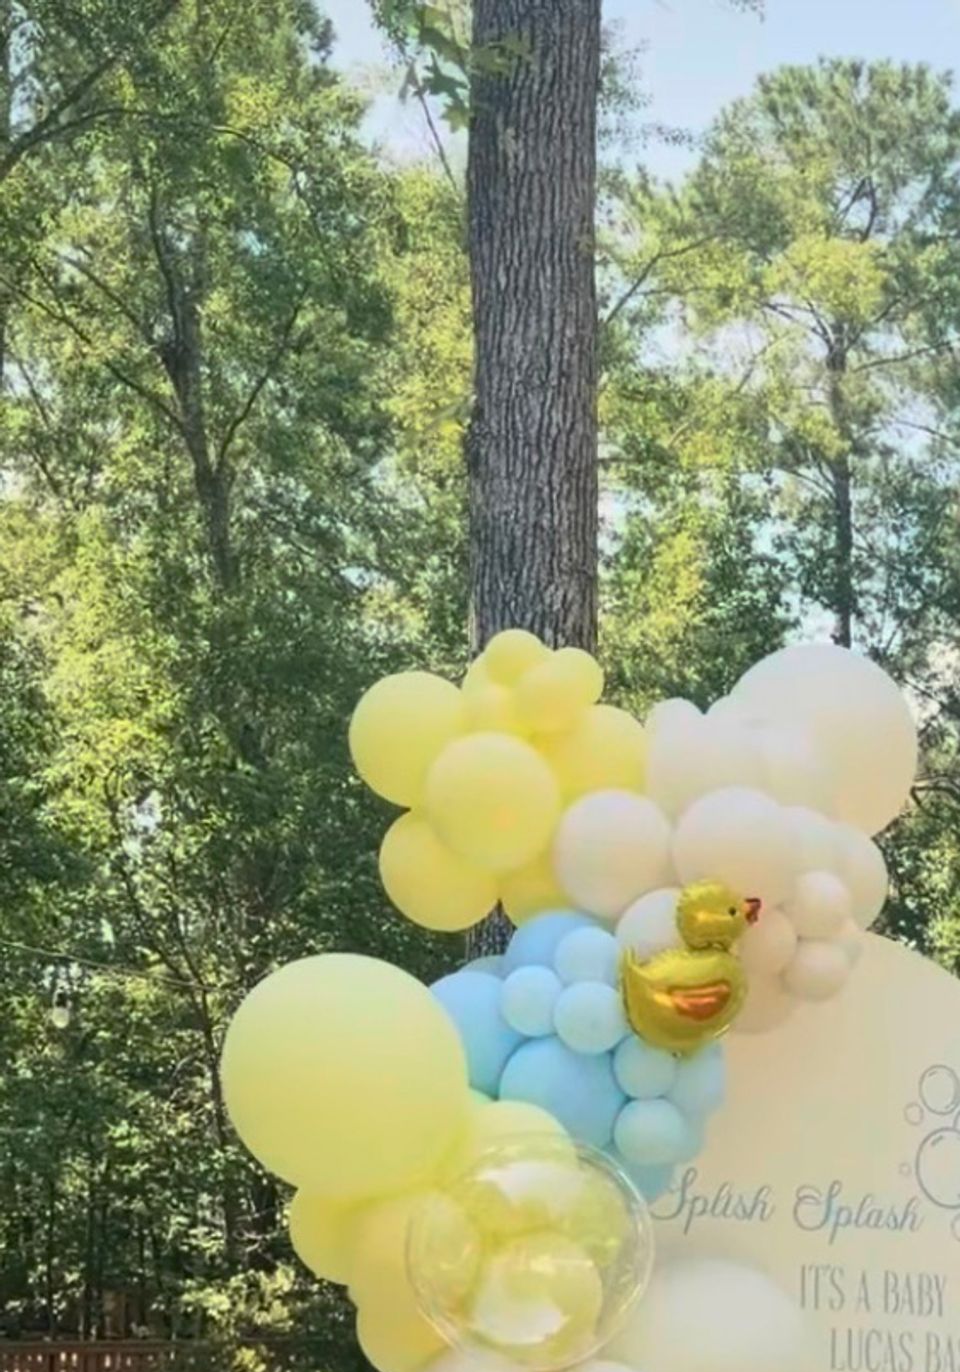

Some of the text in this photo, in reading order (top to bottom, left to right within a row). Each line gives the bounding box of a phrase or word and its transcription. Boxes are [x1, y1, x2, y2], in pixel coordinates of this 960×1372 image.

[649, 1167, 924, 1245] Splish Splash
[799, 1264, 947, 1317] IT'S A BABY
